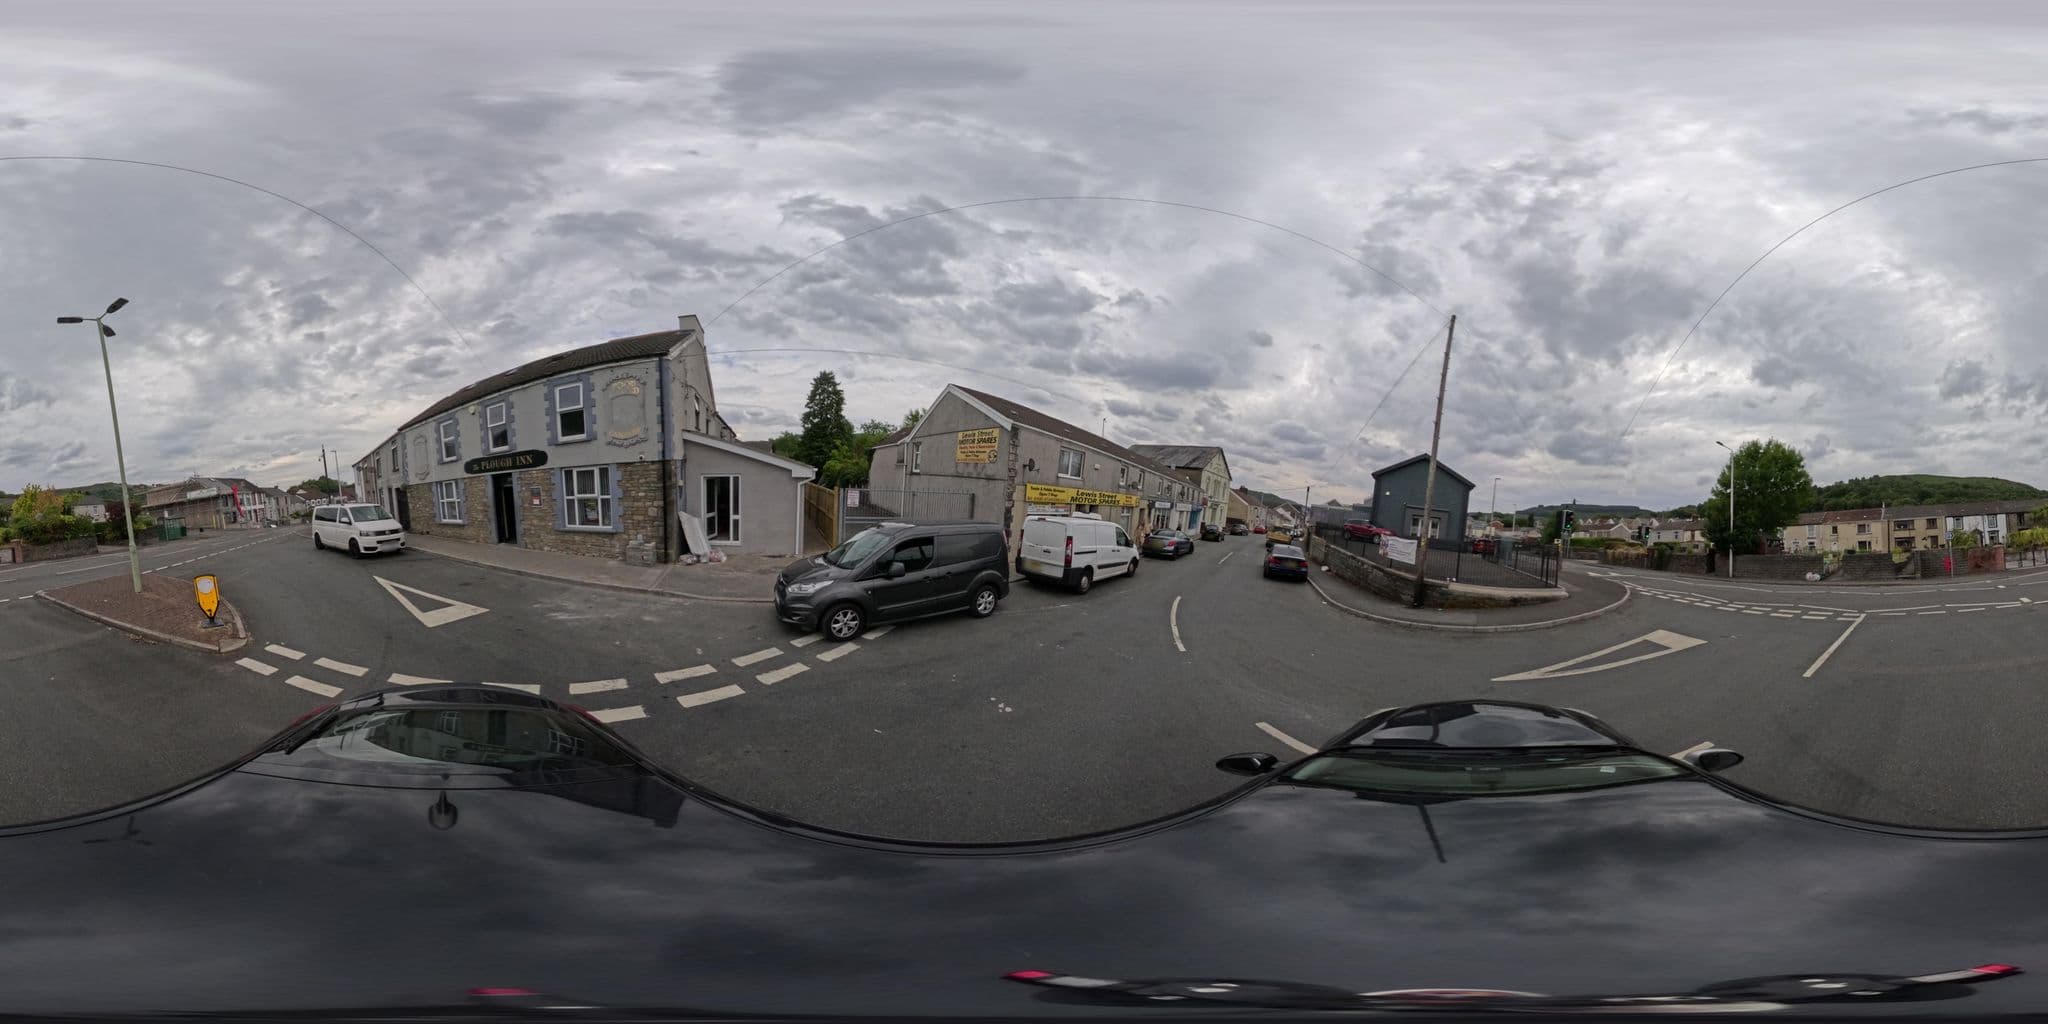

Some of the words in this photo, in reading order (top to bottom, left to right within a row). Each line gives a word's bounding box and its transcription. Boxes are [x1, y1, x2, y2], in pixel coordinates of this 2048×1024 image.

[977, 430, 994, 438] Street
[976, 437, 997, 445] SPARES
[481, 457, 512, 470] PLOUGH
[516, 454, 533, 465] INN
[1098, 492, 1117, 500] Street
[1070, 496, 1098, 504] MOTOR
[1098, 498, 1121, 506] SPARES
